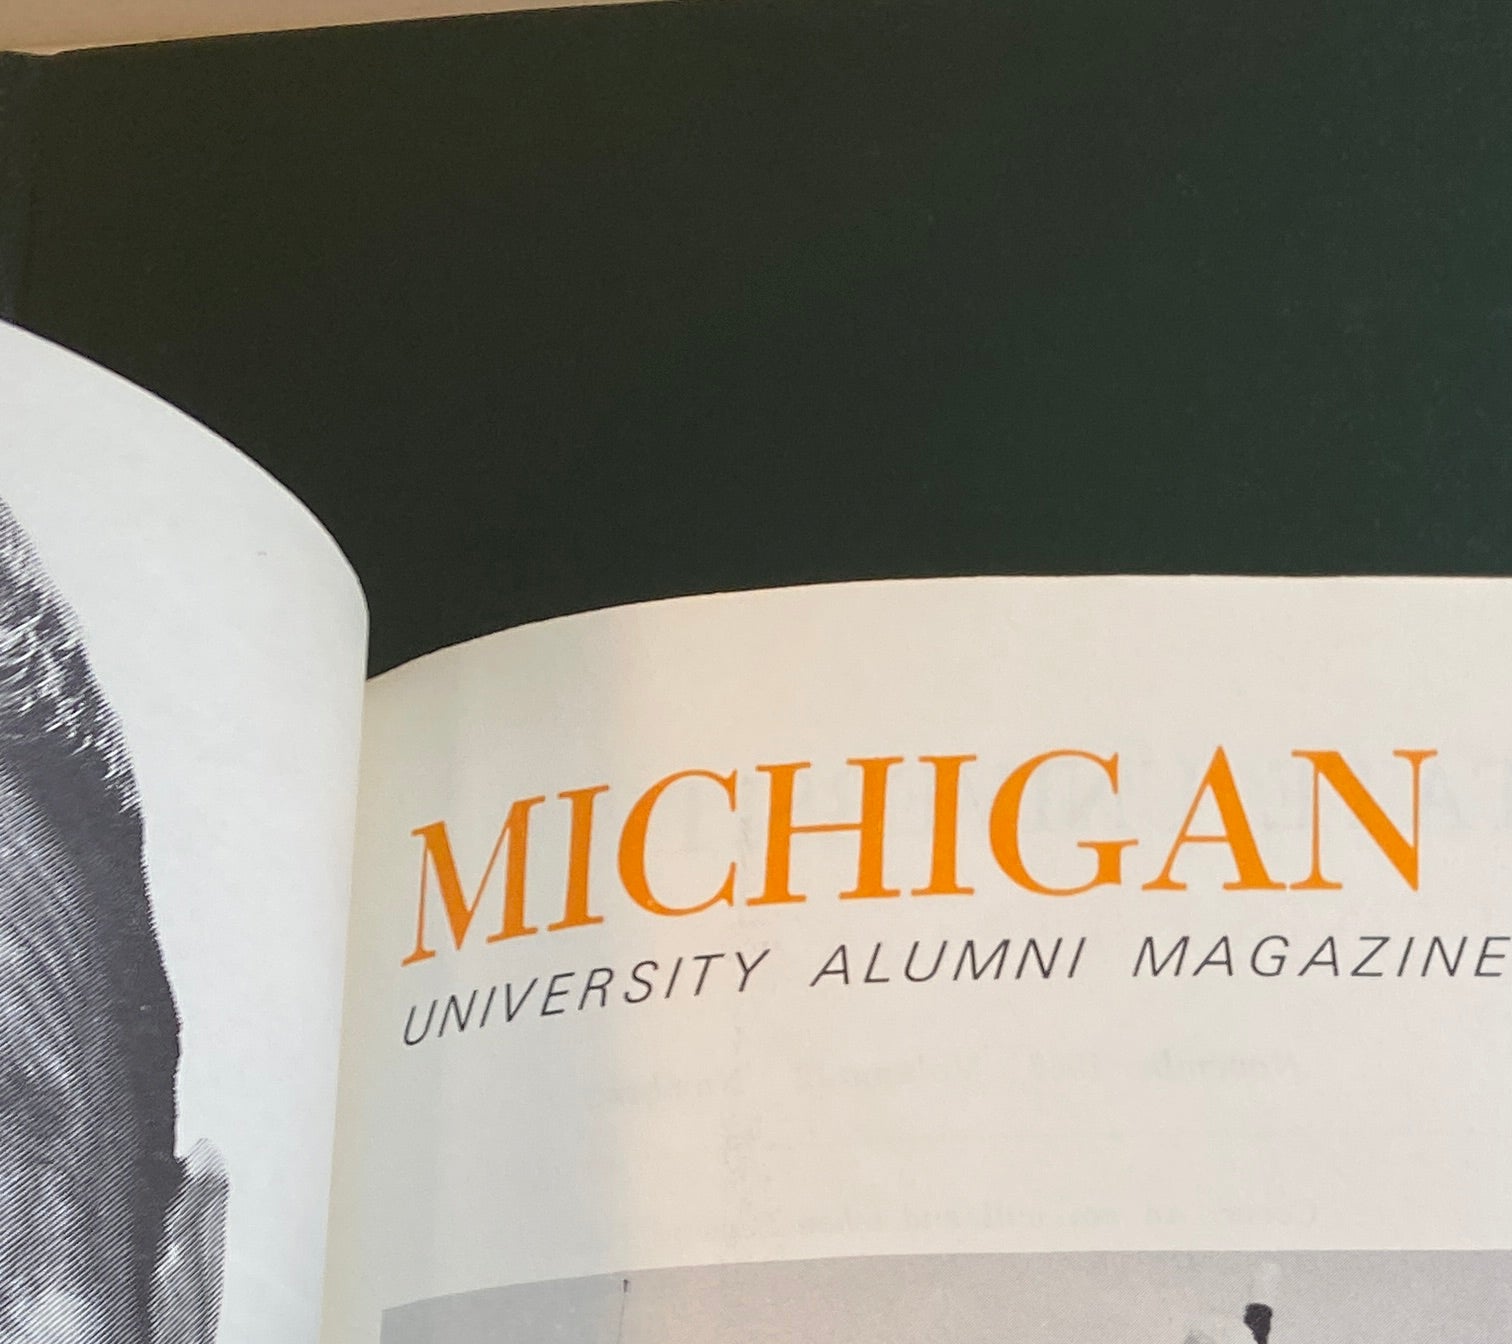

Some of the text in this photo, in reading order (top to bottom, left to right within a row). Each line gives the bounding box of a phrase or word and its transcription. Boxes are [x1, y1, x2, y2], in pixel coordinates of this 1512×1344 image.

[402, 746, 1437, 966] MICHIGAN
[402, 948, 771, 1046] UNIVERSITY
[810, 936, 1087, 988] ALUMNI
[1132, 934, 1512, 978] MAGAZINE
